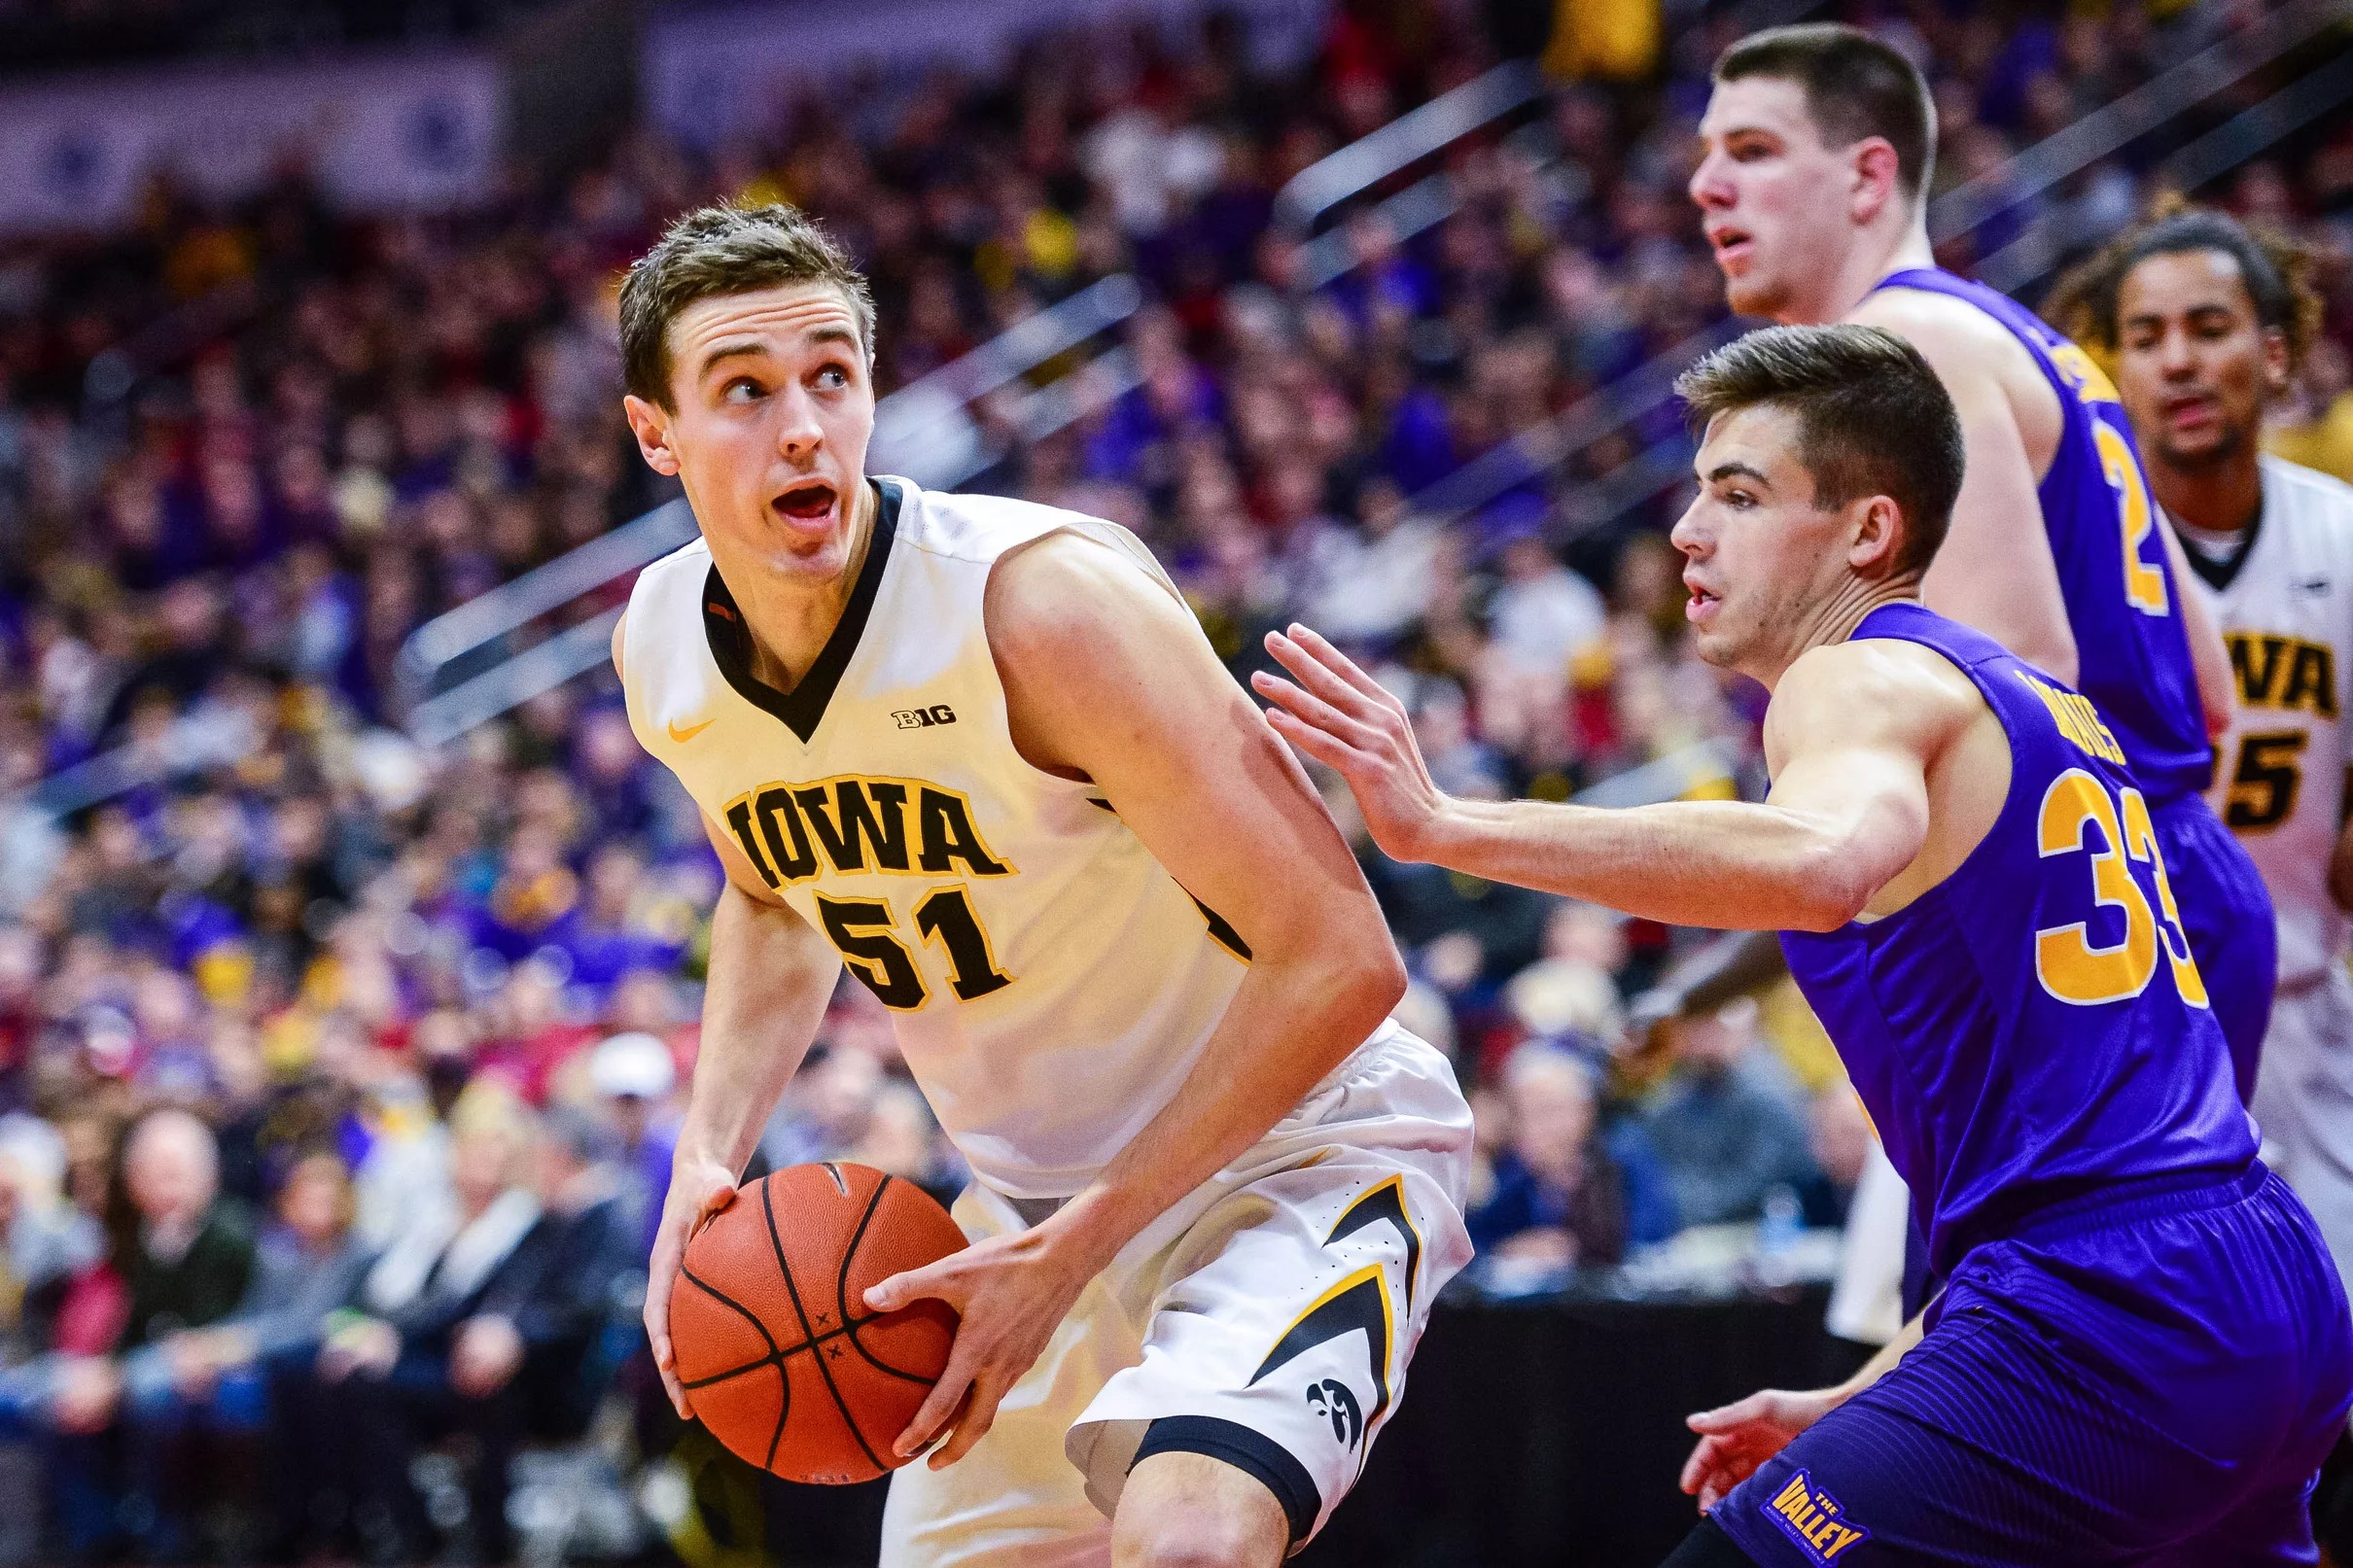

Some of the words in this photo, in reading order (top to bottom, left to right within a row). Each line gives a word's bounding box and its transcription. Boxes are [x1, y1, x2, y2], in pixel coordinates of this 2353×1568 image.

[2224, 632, 2338, 717] WA
[721, 774, 1019, 893] IOWA
[2211, 731, 2310, 834] 5
[2036, 768, 2209, 1009] 33
[813, 883, 1019, 1013] 51
[1773, 1474, 1863, 1559] VALLEY
[1815, 1492, 1839, 1516] THE
